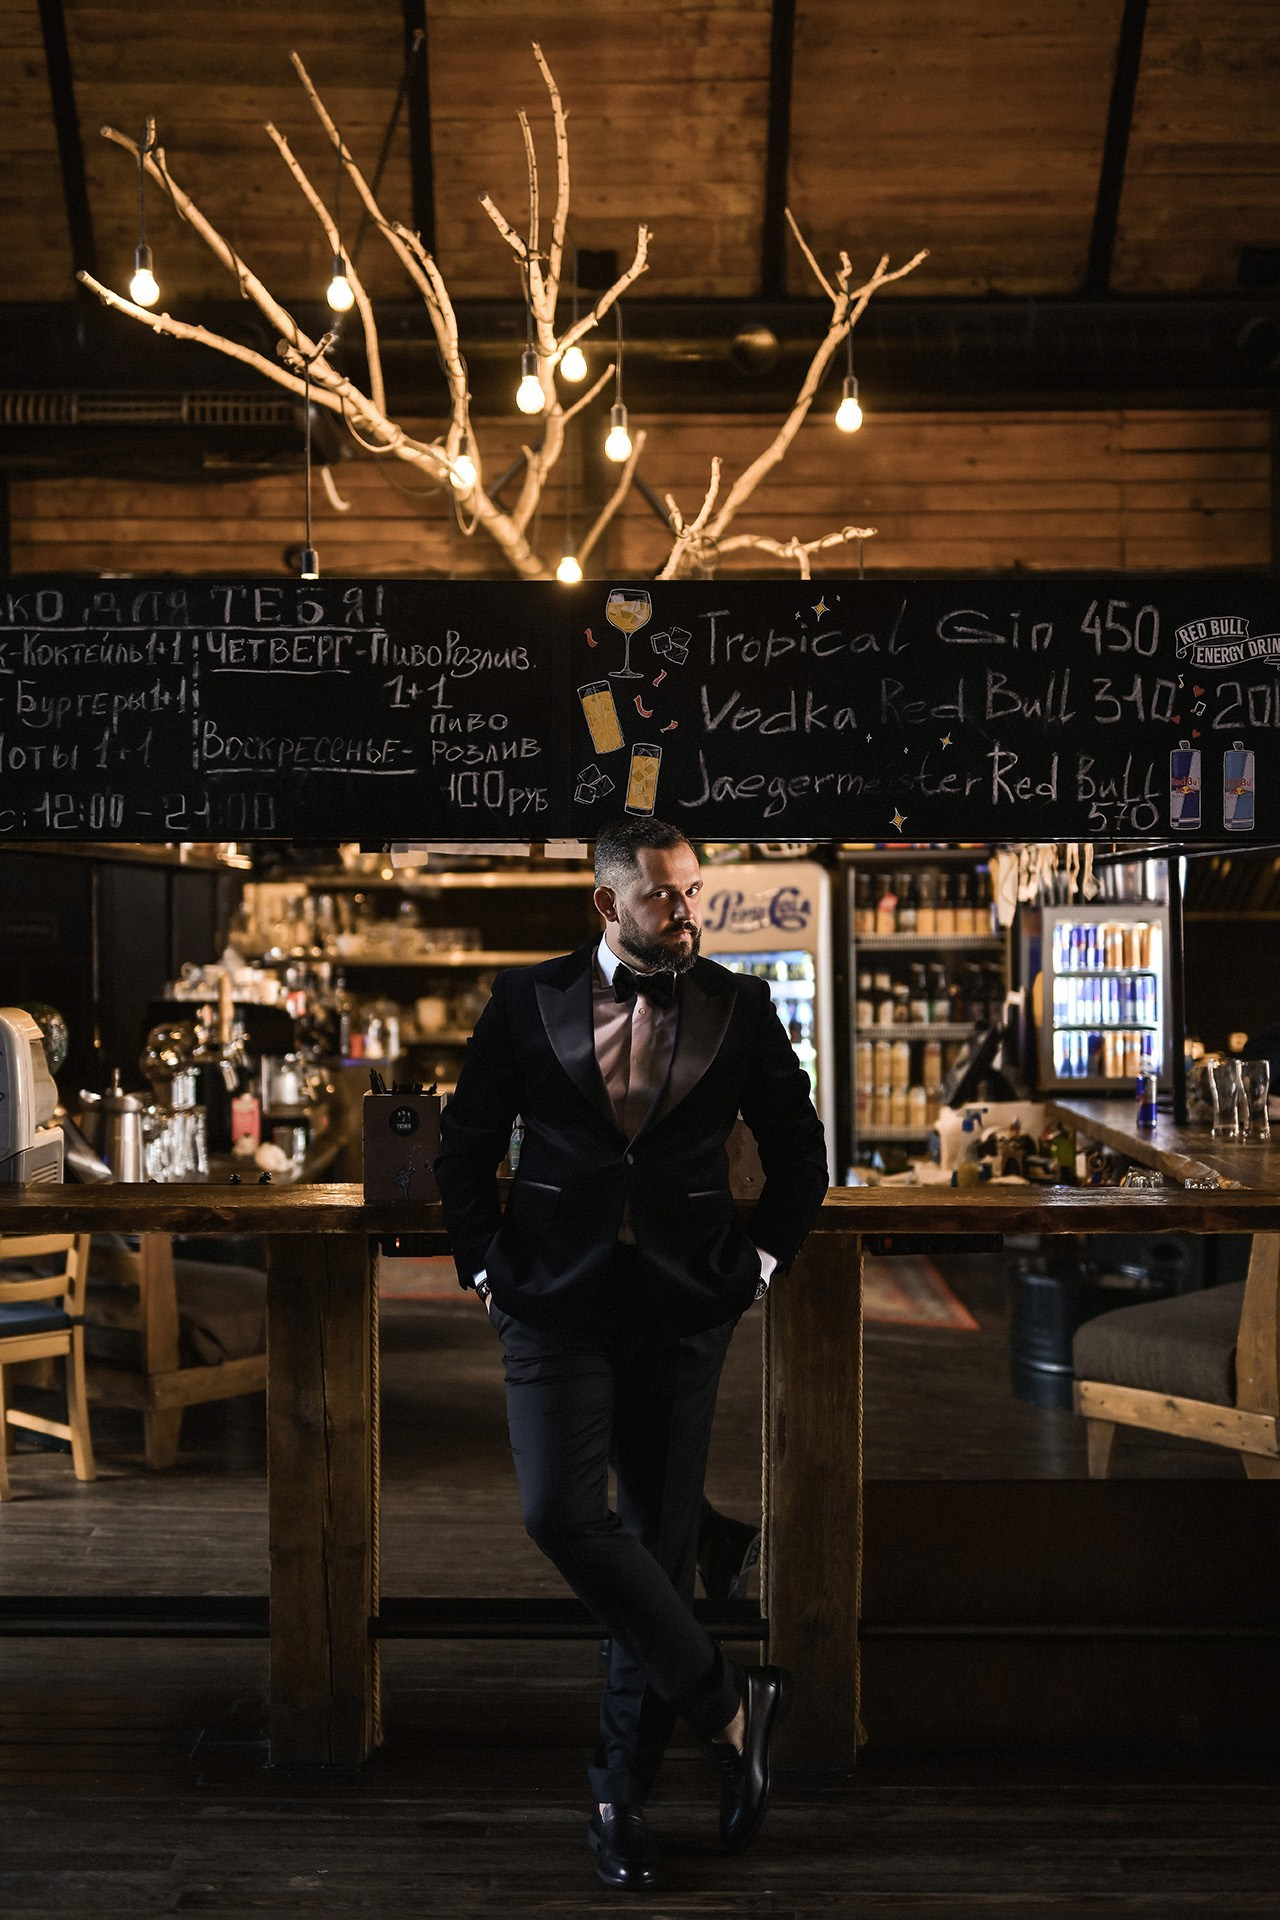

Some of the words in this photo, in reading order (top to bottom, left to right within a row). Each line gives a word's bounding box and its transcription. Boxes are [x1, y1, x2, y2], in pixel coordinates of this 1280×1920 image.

[0, 591, 63, 624] КО
[210, 584, 385, 626] ТЕБЯ!
[698, 600, 909, 667] Tropical
[936, 609, 1053, 652] Gin
[1081, 600, 1160, 656] 450
[1179, 622, 1207, 645] RED
[1210, 618, 1244, 636] BULL
[1196, 643, 1244, 664] ENERGY
[383, 674, 454, 709] 1+1
[701, 685, 858, 735] Vodka
[880, 677, 965, 725] Red
[985, 667, 1077, 725] Bull
[1093, 673, 1177, 725] 310
[441, 769, 505, 808] 100
[985, 738, 1058, 805] Red
[33, 791, 125, 830] 12:00
[1088, 800, 1160, 833] 570
